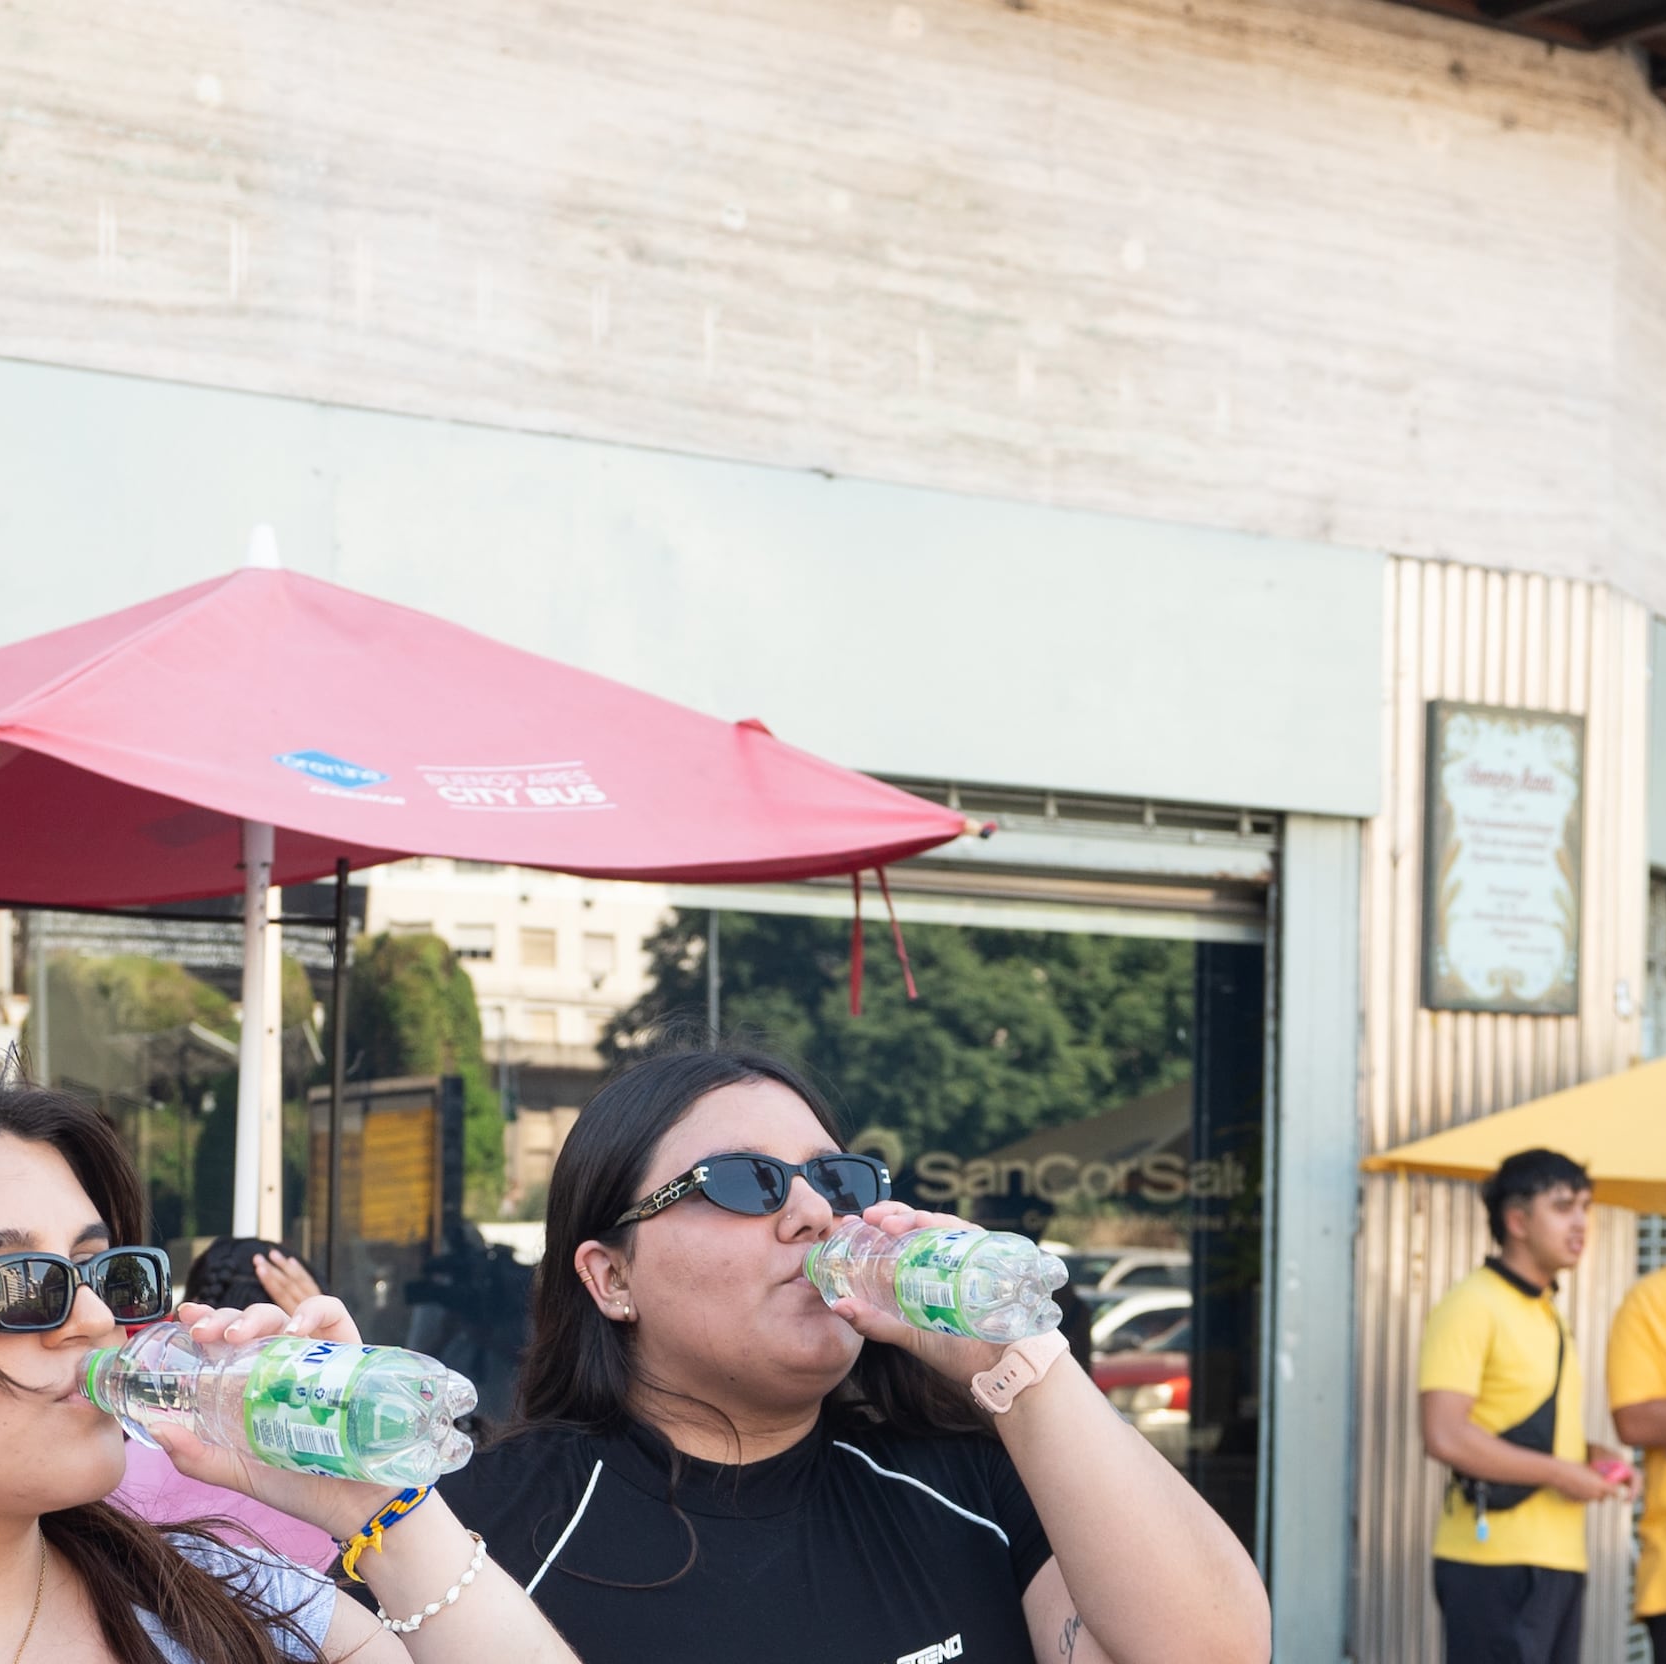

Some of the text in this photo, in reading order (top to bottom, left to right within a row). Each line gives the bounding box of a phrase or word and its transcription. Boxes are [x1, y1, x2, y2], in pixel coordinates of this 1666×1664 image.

[422, 769, 594, 788] BUENOS AIRES
[437, 783, 607, 806] CITY BUS
